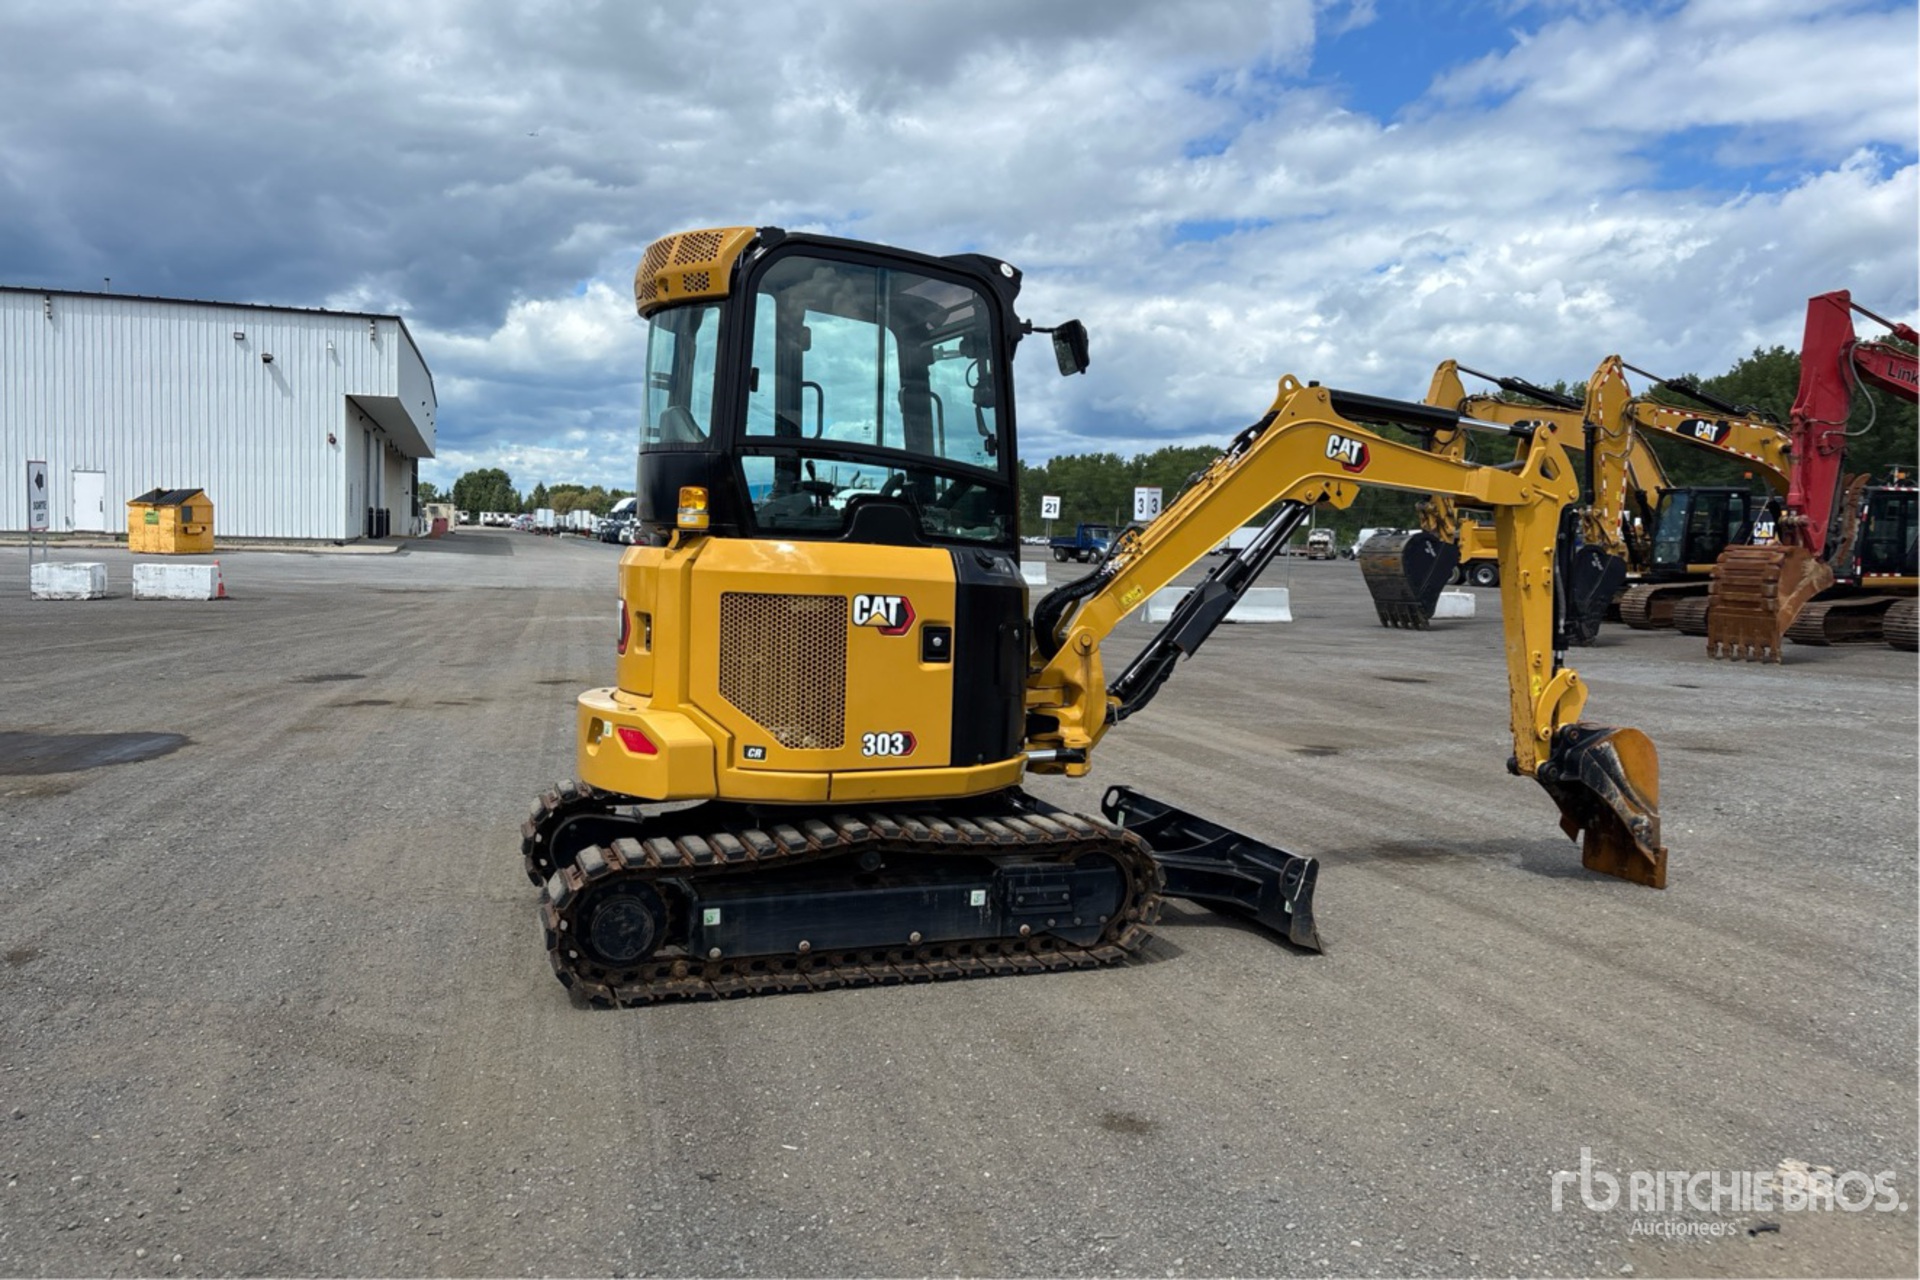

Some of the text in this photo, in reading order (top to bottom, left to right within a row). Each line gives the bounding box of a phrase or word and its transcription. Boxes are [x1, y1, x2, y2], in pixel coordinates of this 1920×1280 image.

[1695, 420, 1719, 441] CAT
[1326, 434, 1362, 465] CAT
[1044, 502, 1057, 514] 21
[1137, 498, 1145, 514] 3
[1151, 498, 1159, 514] 3
[1753, 521, 1775, 537] CAT
[853, 594, 901, 627] CAT
[862, 733, 904, 756] 303
[747, 748, 763, 758] CR
